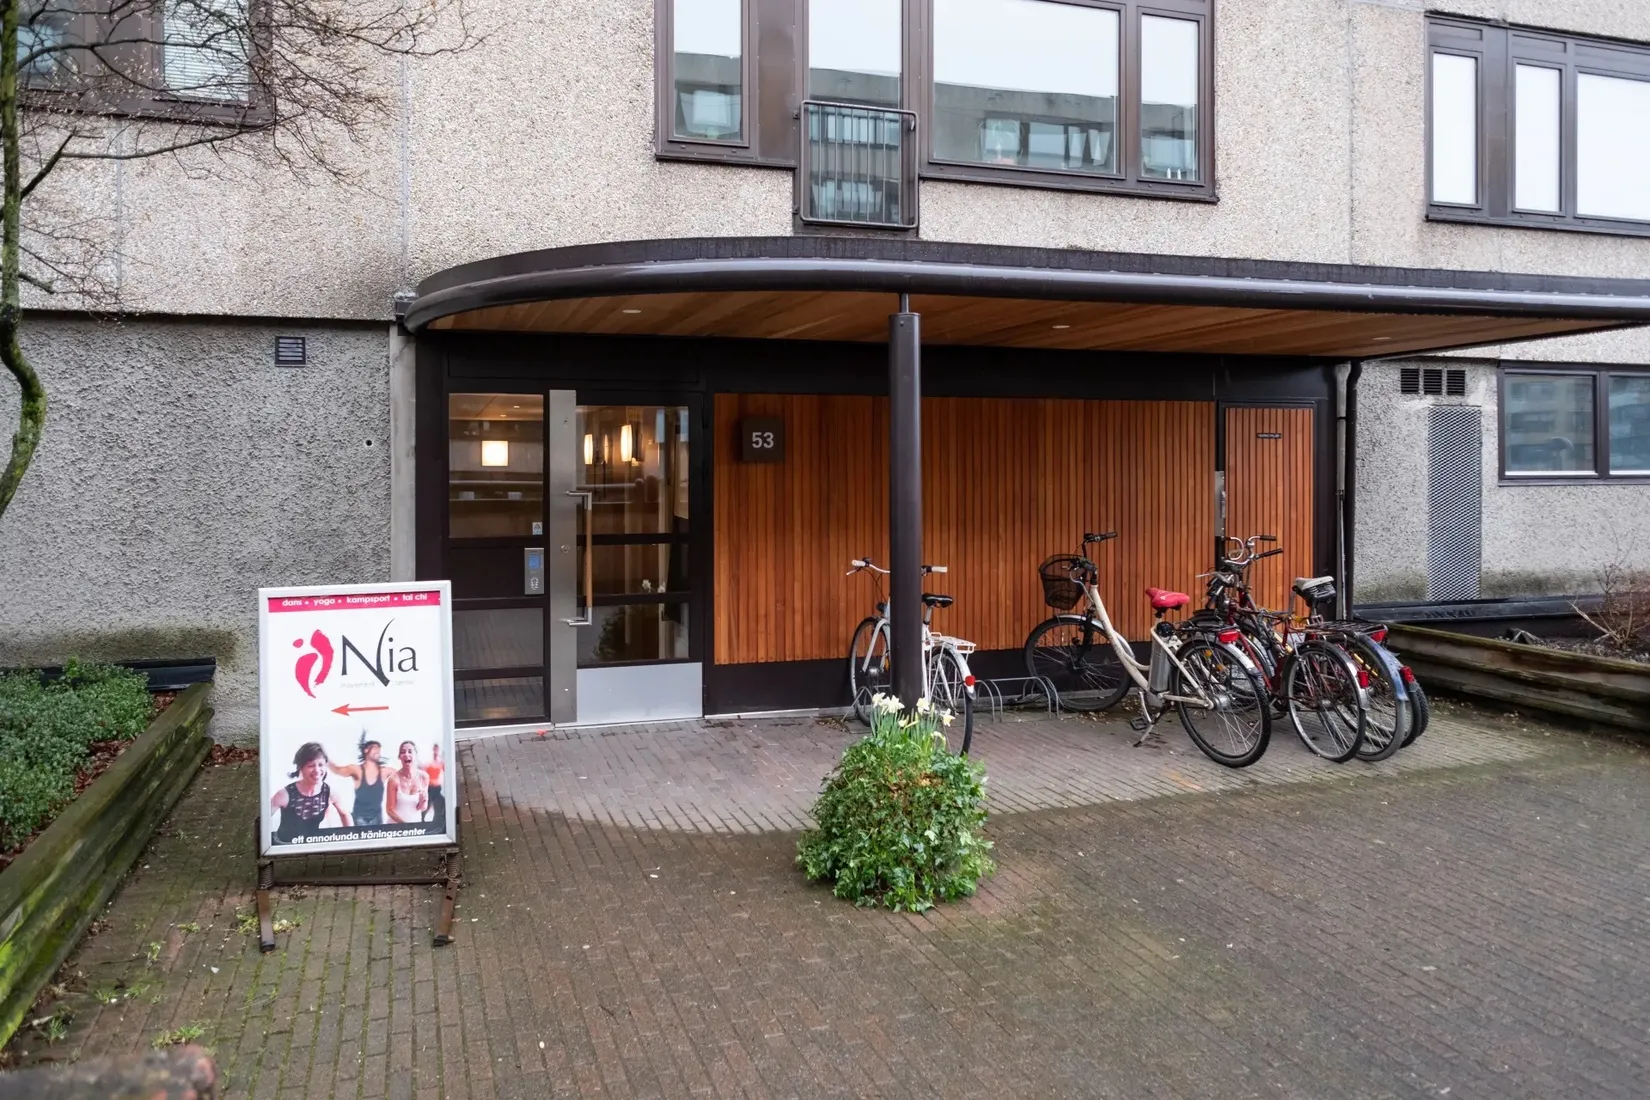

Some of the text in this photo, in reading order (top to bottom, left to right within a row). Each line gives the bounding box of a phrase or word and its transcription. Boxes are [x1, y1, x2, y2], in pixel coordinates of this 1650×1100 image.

[752, 431, 774, 448] 53
[282, 599, 303, 607] dans
[313, 598, 336, 606] yoga
[346, 595, 390, 604] kampsport
[402, 593, 413, 601] tai
[341, 617, 419, 687] Nia
[291, 827, 427, 844] ett annorlunda träningscenter
